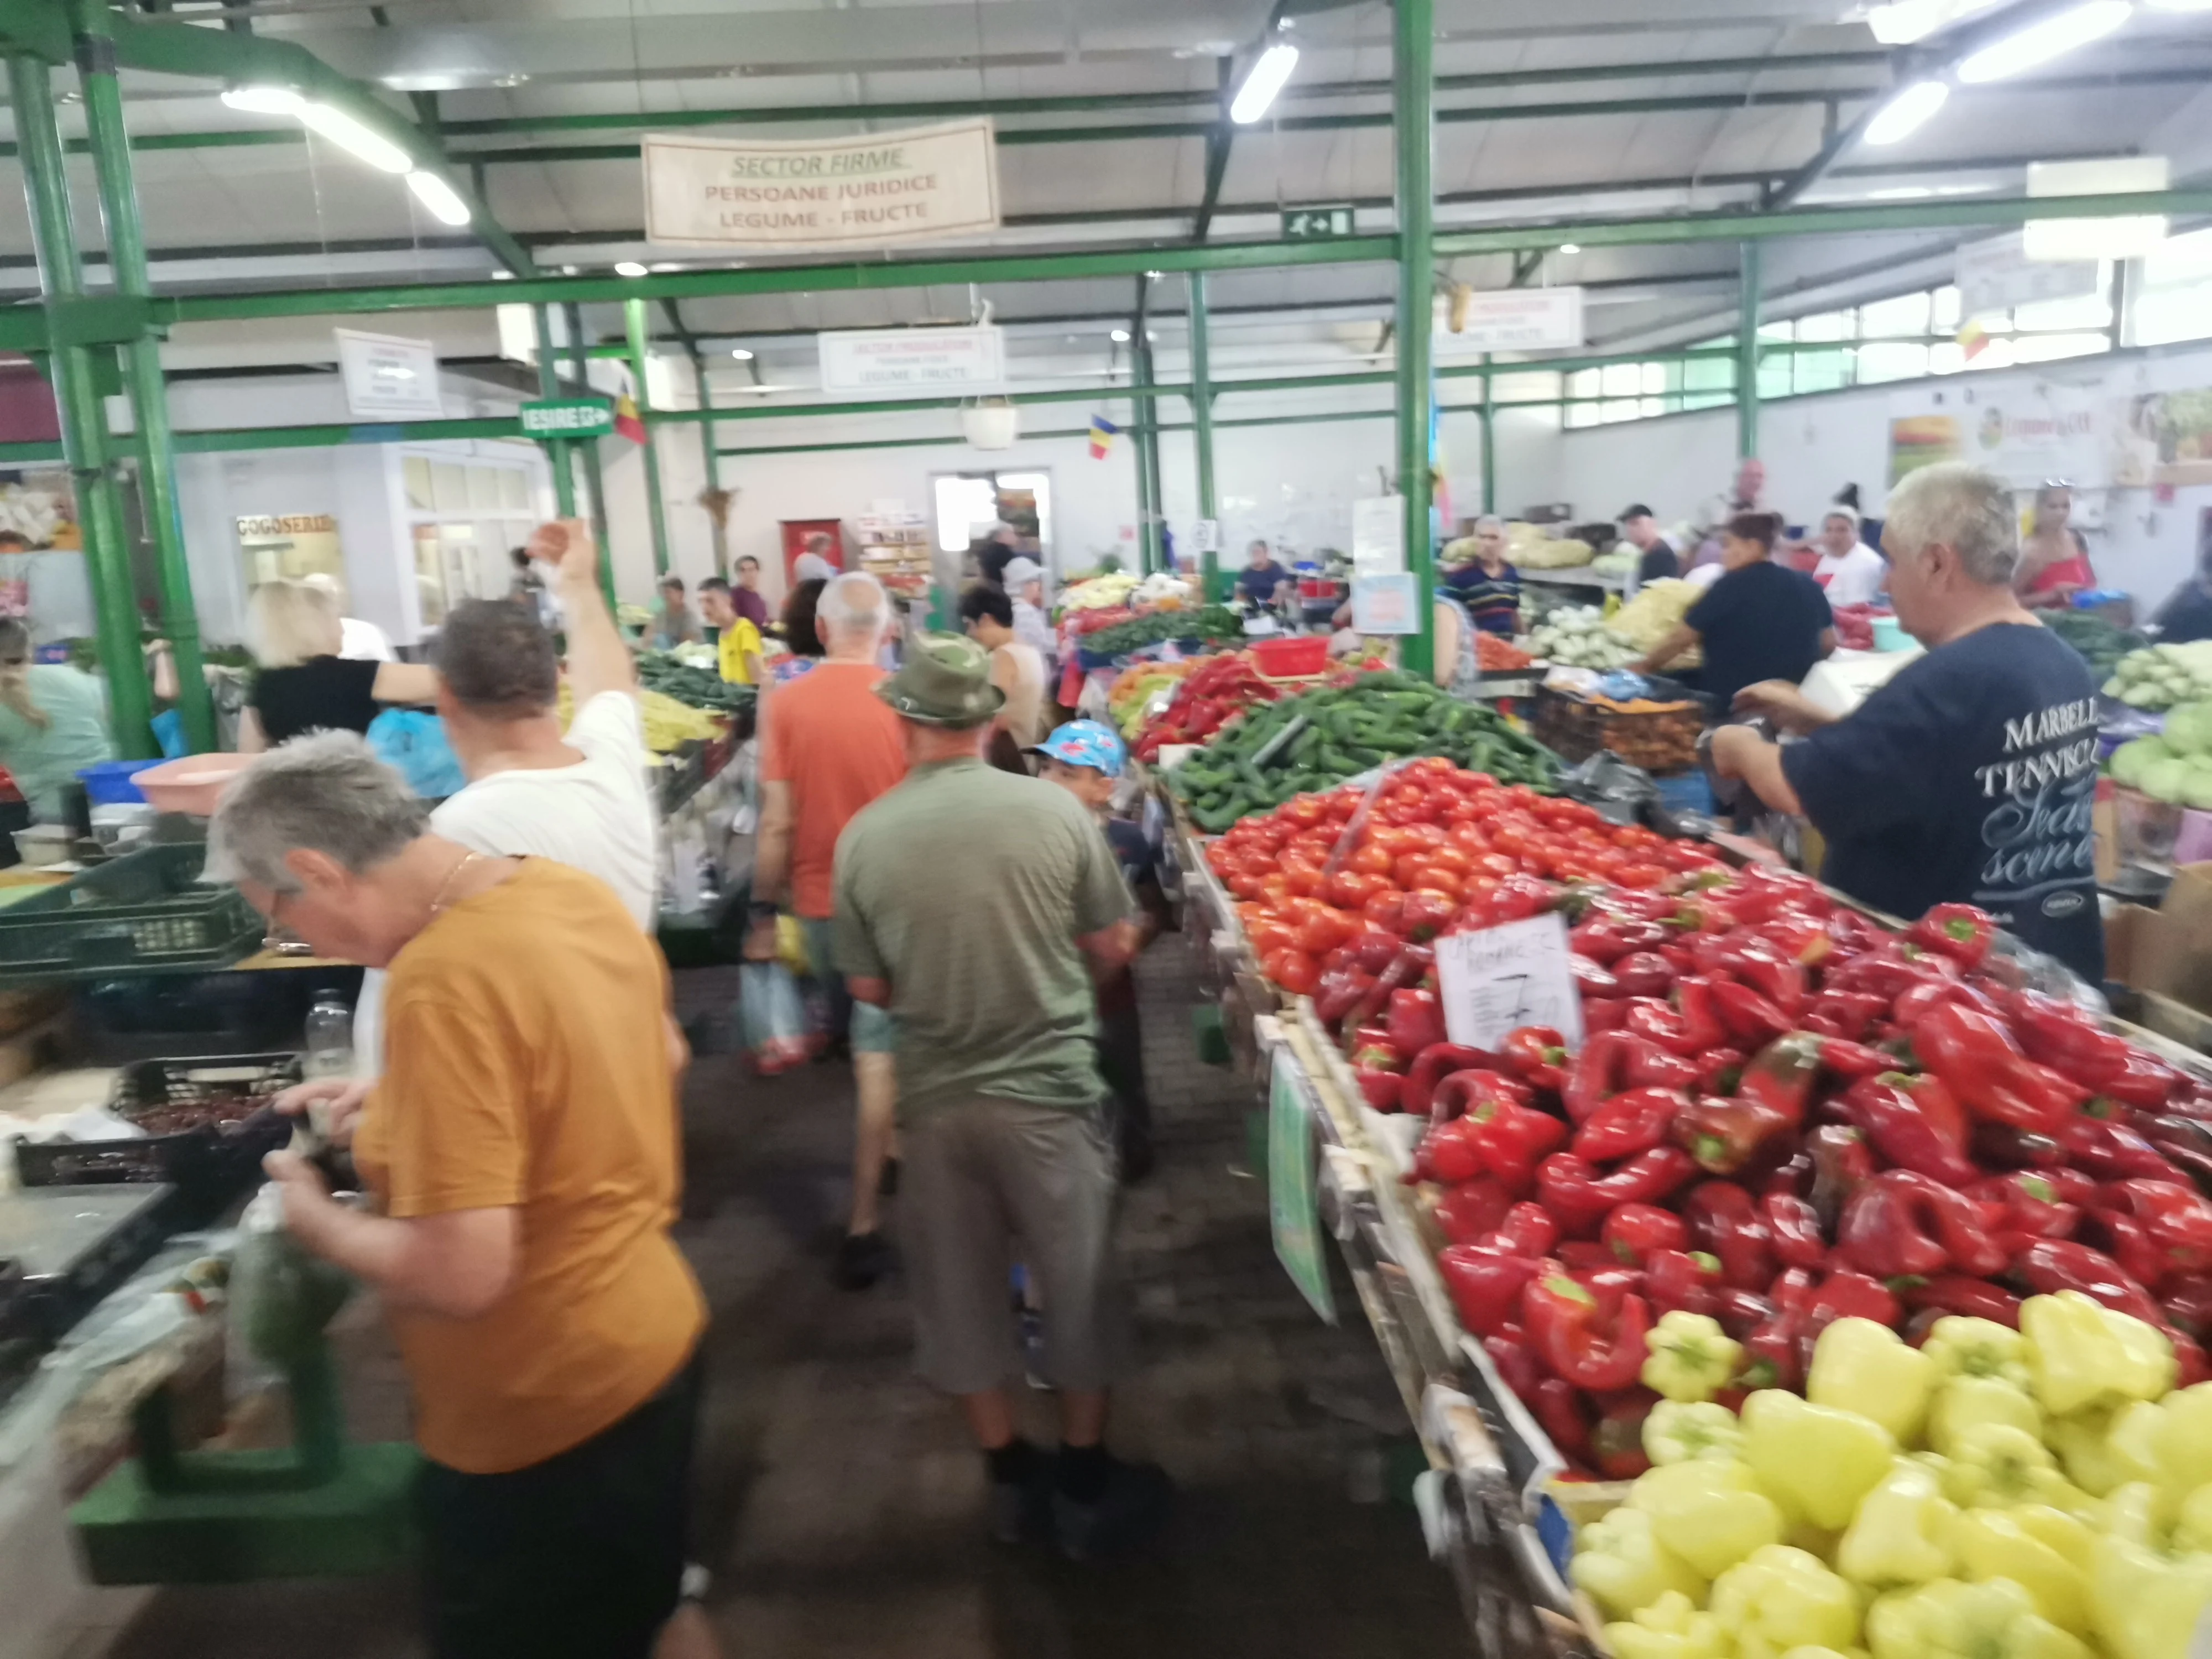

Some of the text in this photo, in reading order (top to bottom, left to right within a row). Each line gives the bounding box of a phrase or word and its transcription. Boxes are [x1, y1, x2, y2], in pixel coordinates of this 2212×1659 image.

[732, 148, 905, 176] SECTOR FIRME
[705, 175, 938, 202] PERSOANE JURIDICE
[719, 211, 818, 228] LEGUME
[841, 202, 928, 225] FRUCTE
